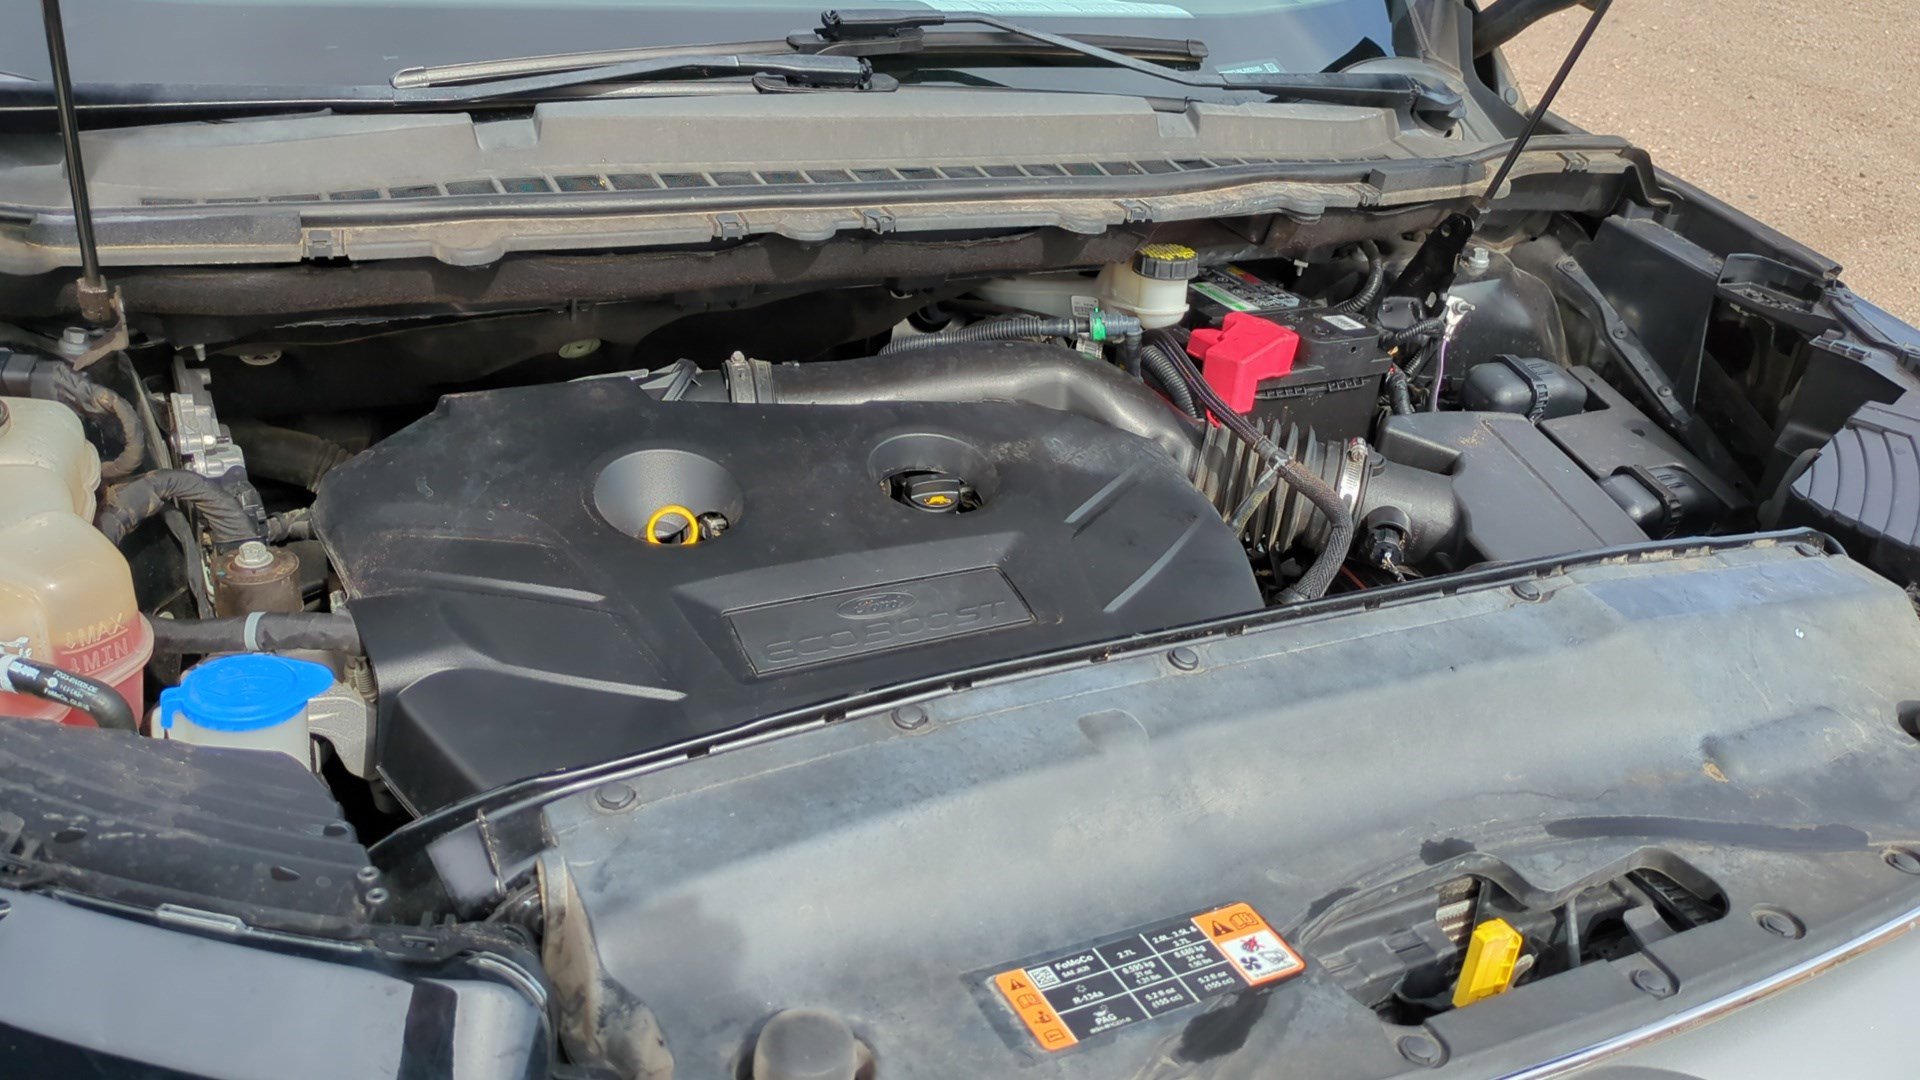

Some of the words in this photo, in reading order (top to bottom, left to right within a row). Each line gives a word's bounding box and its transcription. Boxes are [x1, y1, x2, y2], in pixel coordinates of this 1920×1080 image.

[78, 612, 126, 648] MAX
[766, 601, 1006, 664] ECOBOOST
[82, 636, 129, 673] MIN
[1054, 954, 1094, 970] FoMoCo
[1115, 949, 1136, 959] 2.7L
[1072, 991, 1105, 1005] R-134a
[1094, 1012, 1117, 1025] PAG
